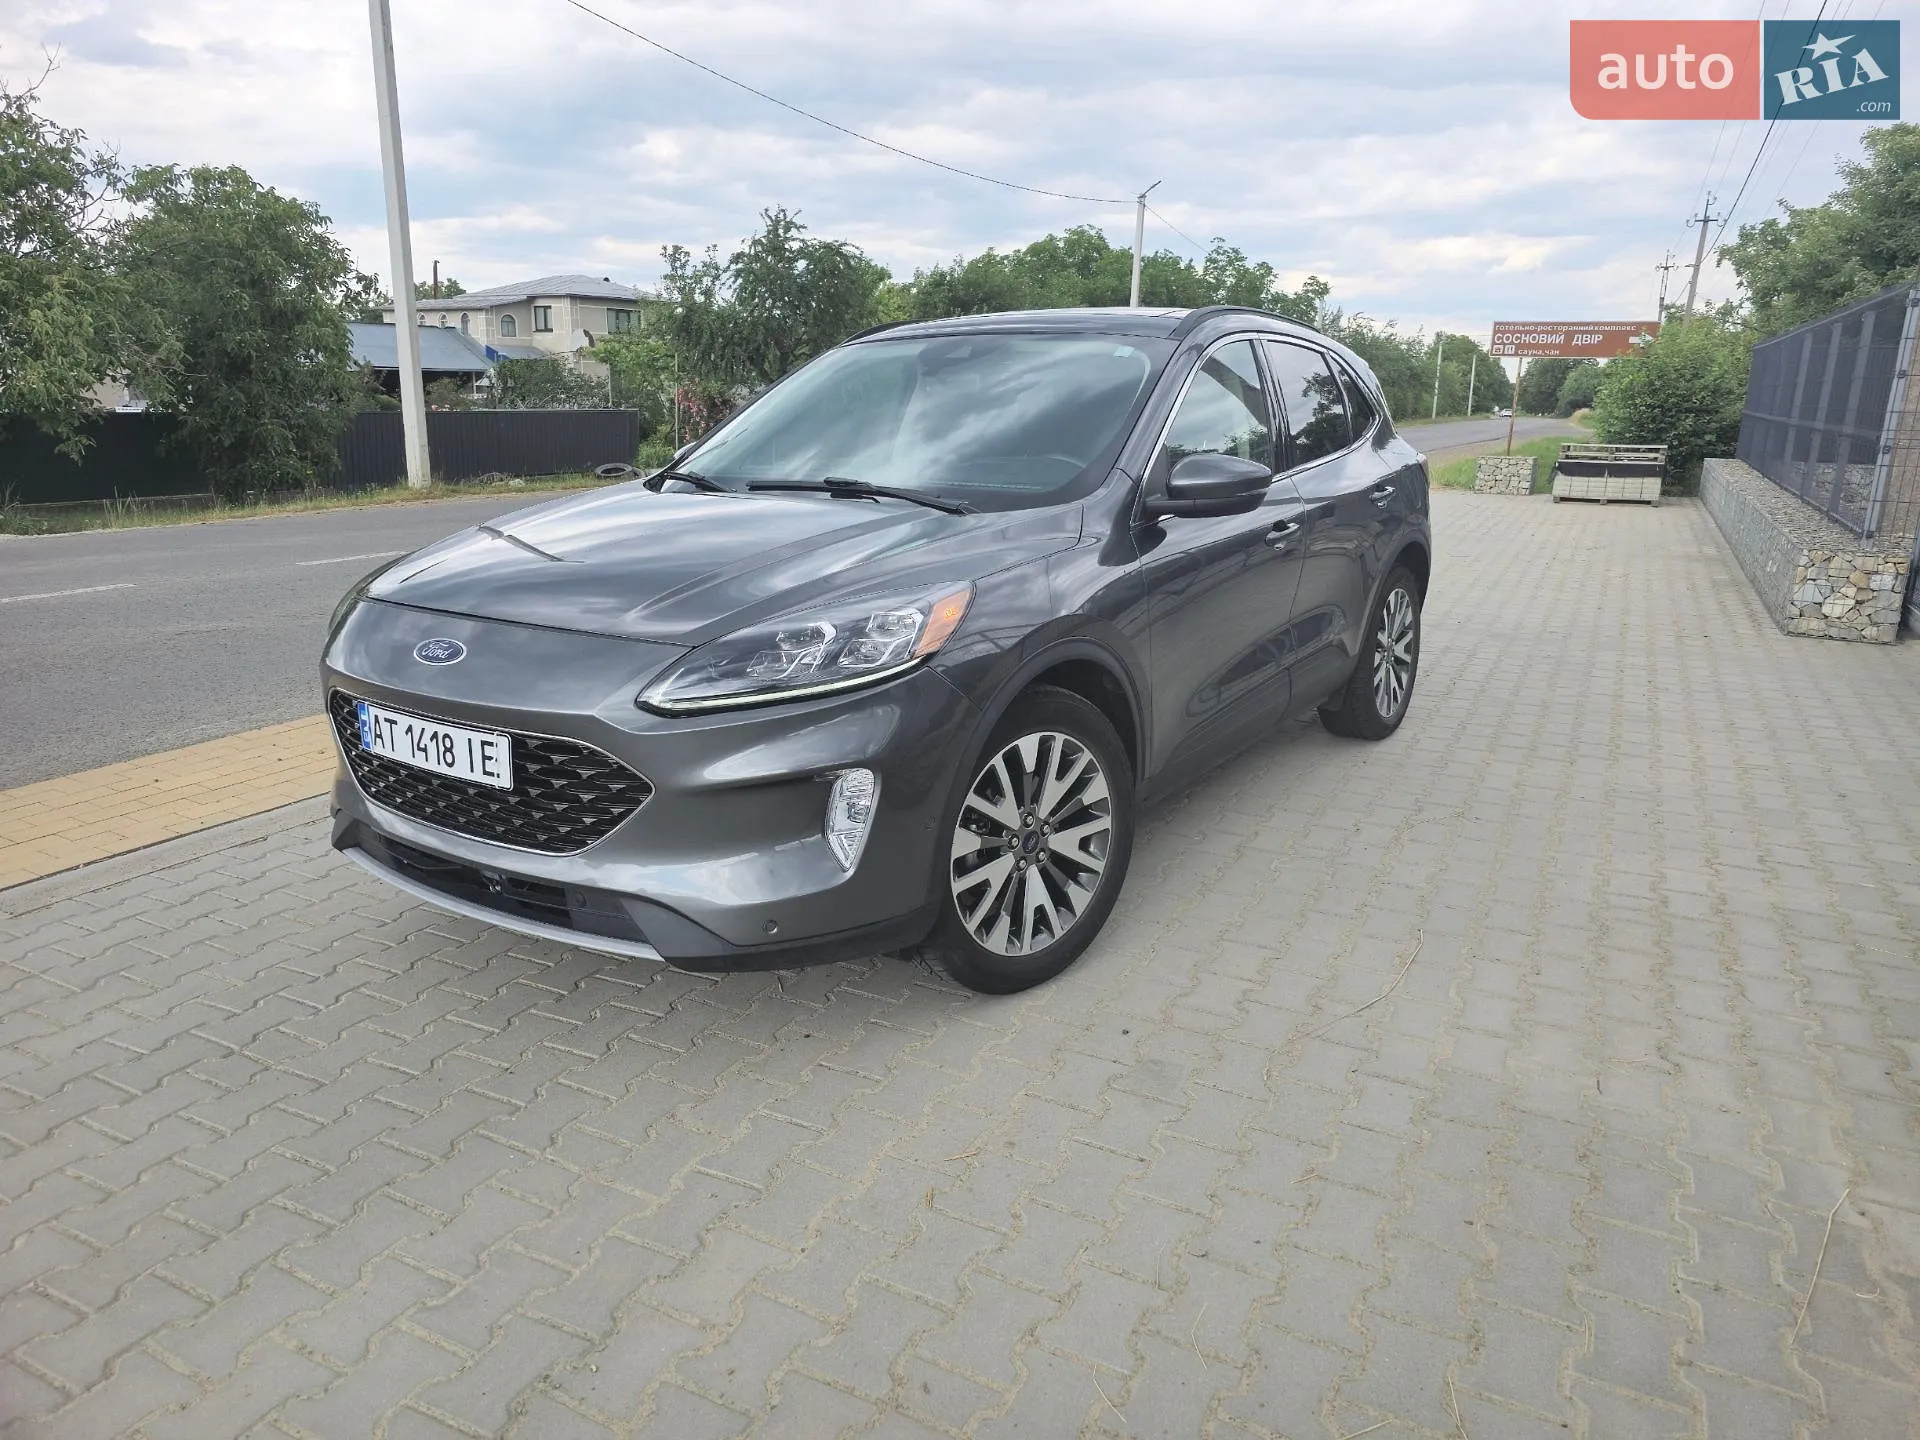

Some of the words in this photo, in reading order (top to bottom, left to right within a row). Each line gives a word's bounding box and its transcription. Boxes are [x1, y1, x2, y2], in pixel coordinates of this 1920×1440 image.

[1494, 332, 1565, 344] СОСНОВИЙ
[1572, 334, 1603, 346] ДВІР
[422, 641, 454, 658] Ford
[374, 714, 398, 752] AT
[405, 724, 456, 768] 1418
[468, 737, 500, 778] IE
